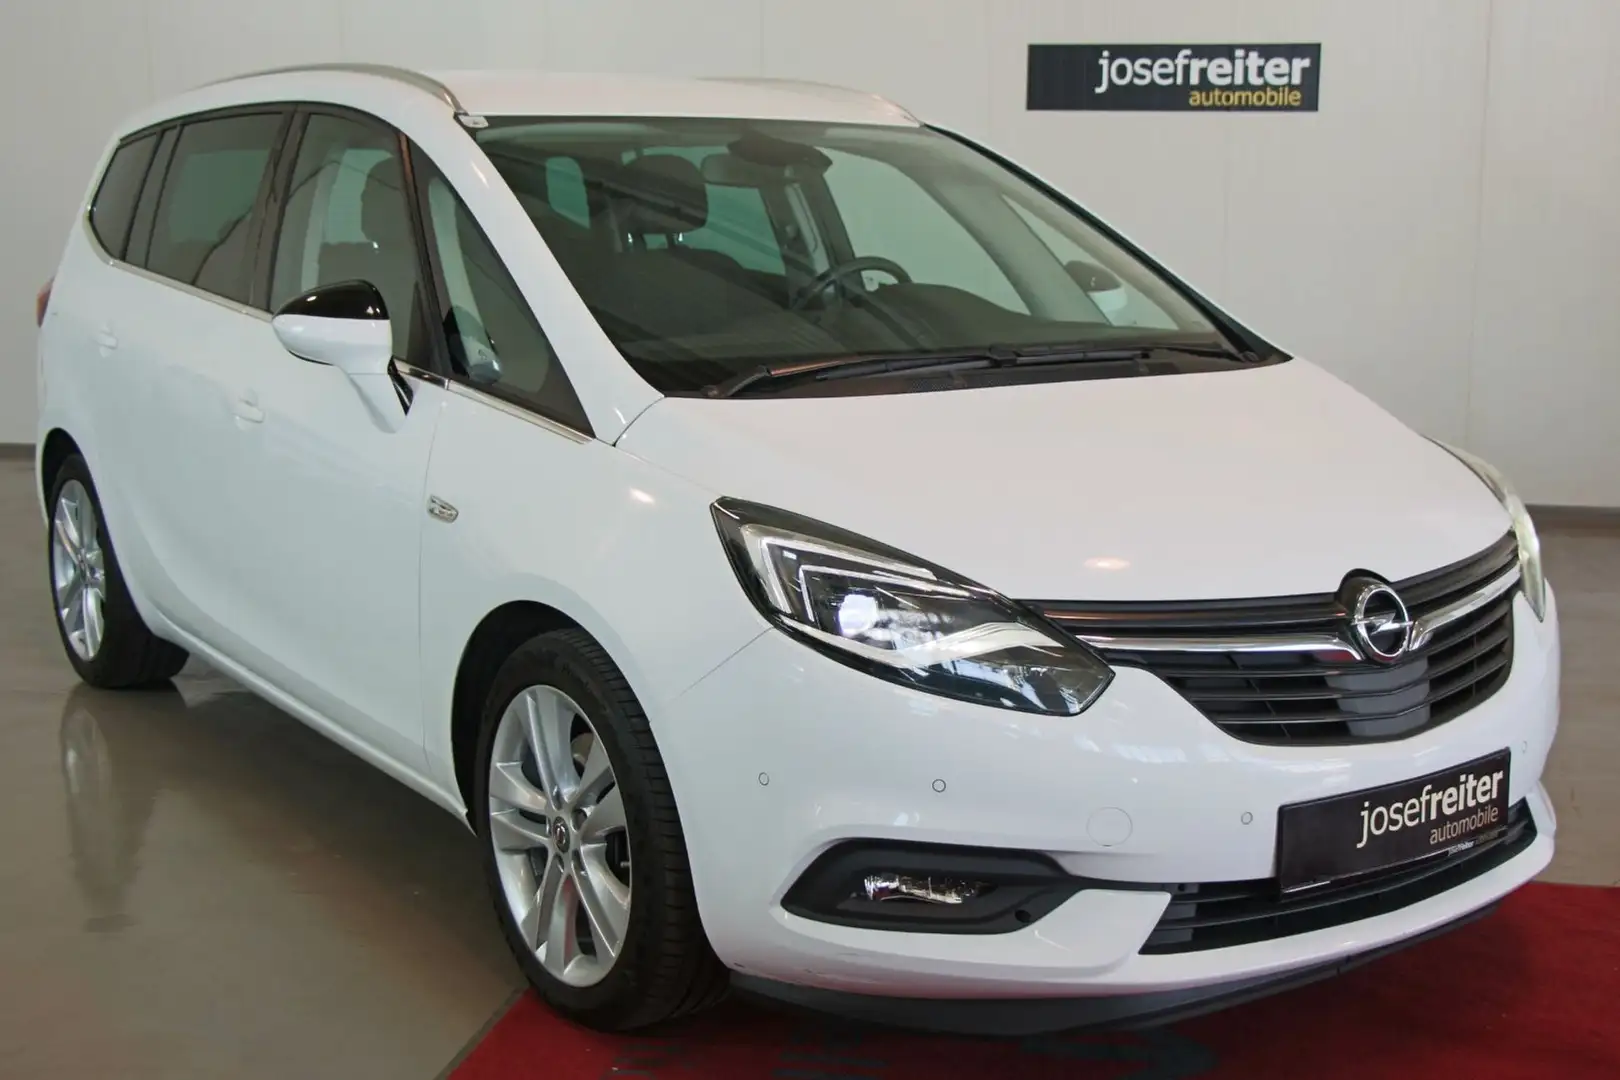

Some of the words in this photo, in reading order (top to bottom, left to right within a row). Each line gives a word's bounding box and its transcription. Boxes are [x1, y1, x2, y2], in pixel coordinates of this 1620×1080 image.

[1094, 49, 1311, 94] josefreiter
[1188, 85, 1302, 106] automobile
[1356, 770, 1504, 849] josefreiter
[1429, 804, 1499, 845] automobile
